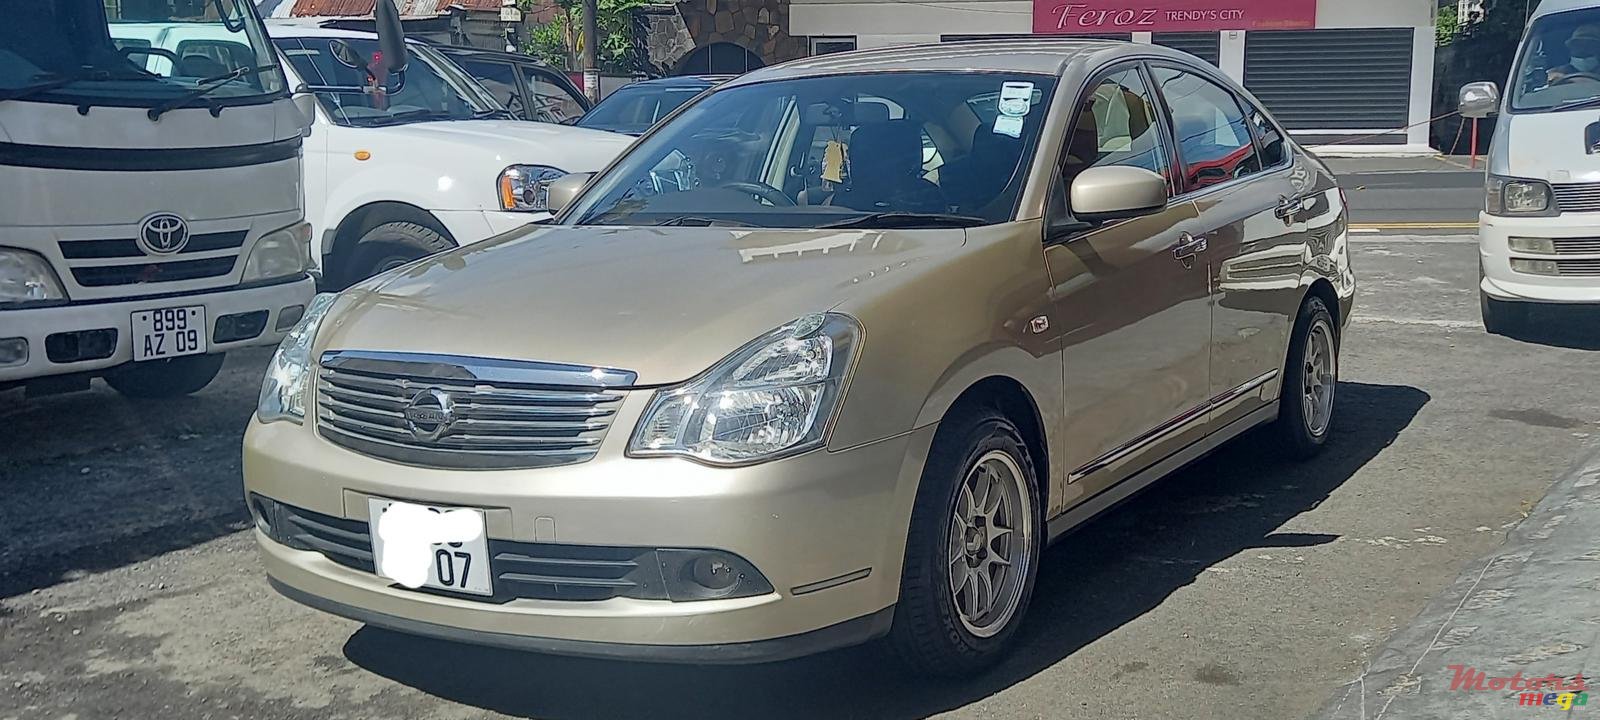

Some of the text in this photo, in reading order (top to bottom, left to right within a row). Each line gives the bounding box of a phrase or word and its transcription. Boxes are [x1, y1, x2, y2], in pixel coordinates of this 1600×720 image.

[1052, 4, 1245, 29] Feroz TRENDY'S CITY
[153, 309, 187, 332] 899
[144, 330, 198, 357] AZ 09
[435, 549, 472, 588] 07
